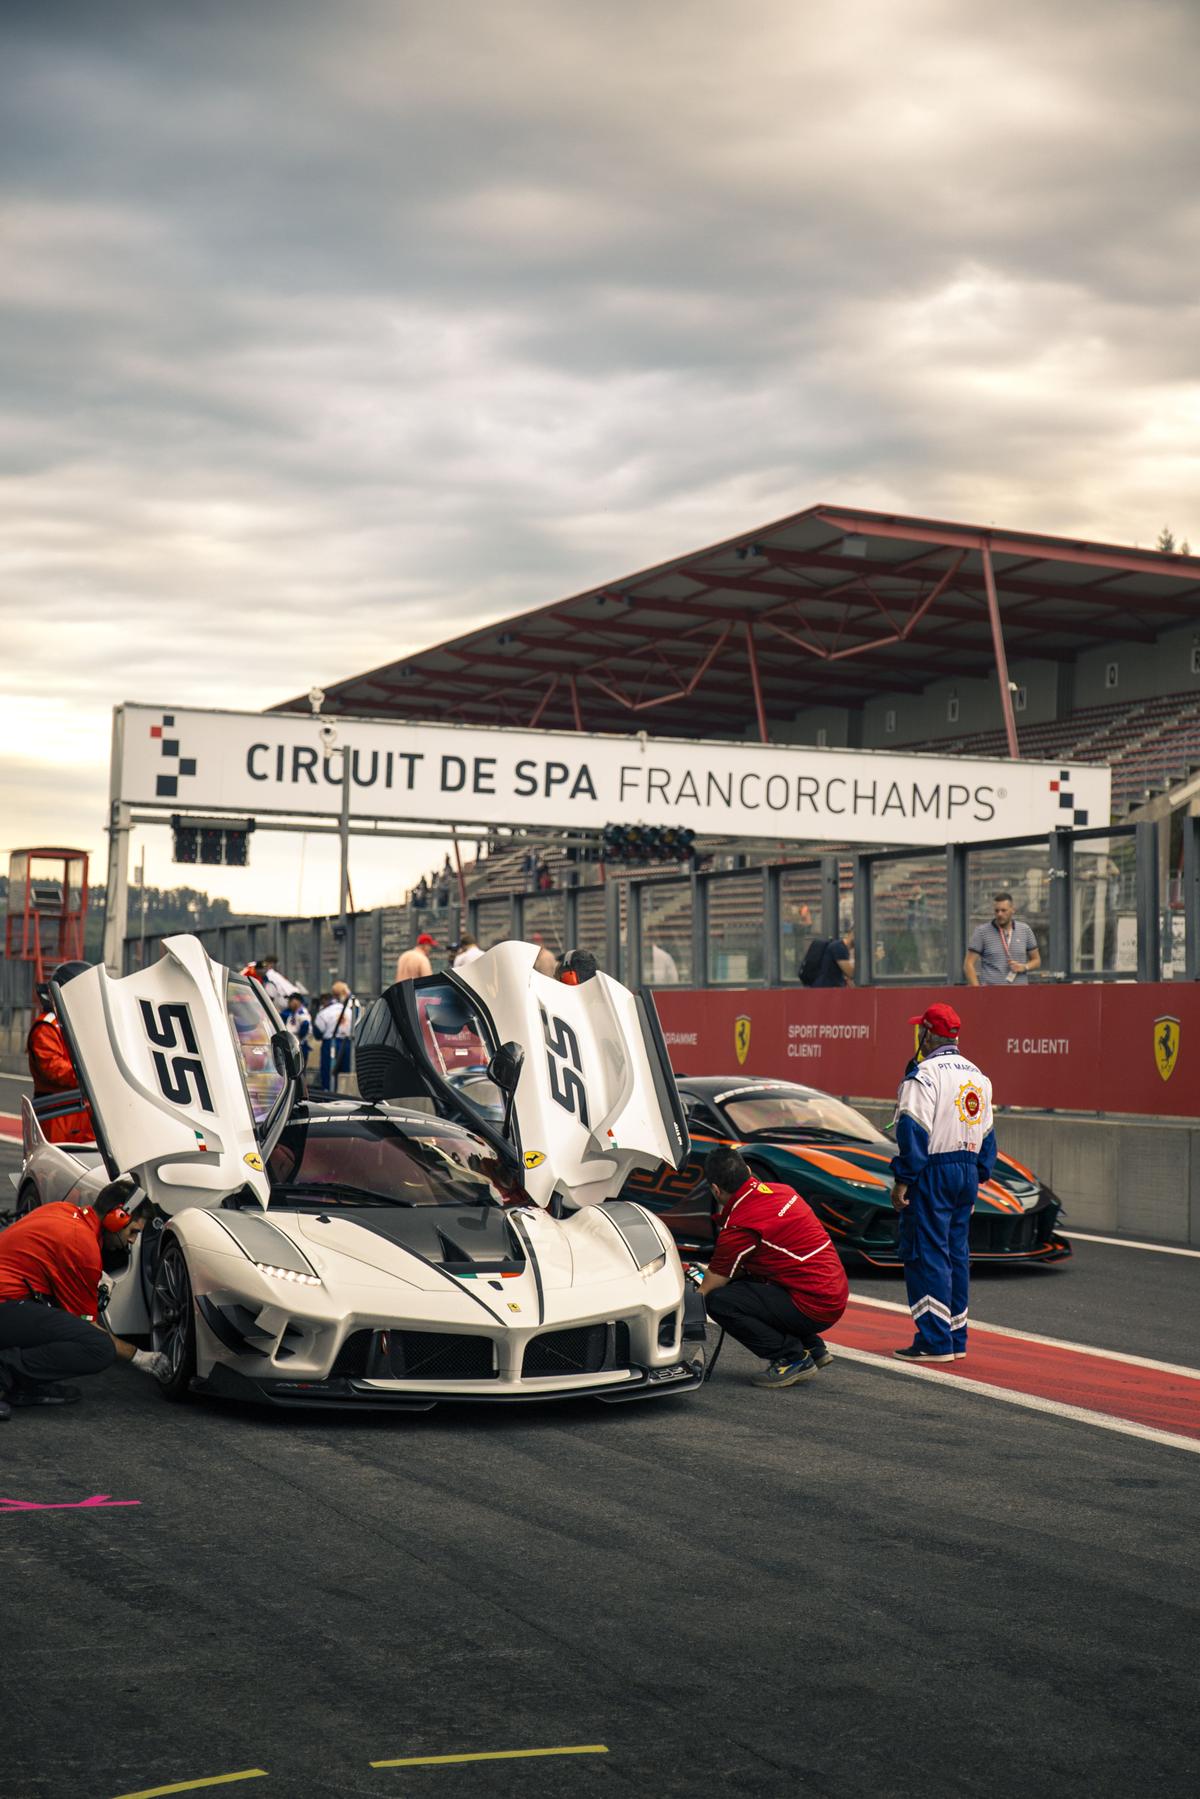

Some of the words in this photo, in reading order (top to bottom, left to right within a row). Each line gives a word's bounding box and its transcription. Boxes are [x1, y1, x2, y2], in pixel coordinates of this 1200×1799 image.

[246, 743, 424, 790] CIRCUIT
[440, 755, 497, 794] DE
[514, 760, 599, 801] SPA
[788, 1025, 818, 1039] SPORT
[819, 1025, 870, 1039] PROTOTIPI
[787, 1044, 822, 1058] CLIENTI
[1007, 1038, 1020, 1053] F1
[1022, 1038, 1069, 1054] CLIENTI
[138, 998, 215, 1114] 55
[538, 1001, 590, 1130] 55
[937, 1062, 952, 1071] PIT
